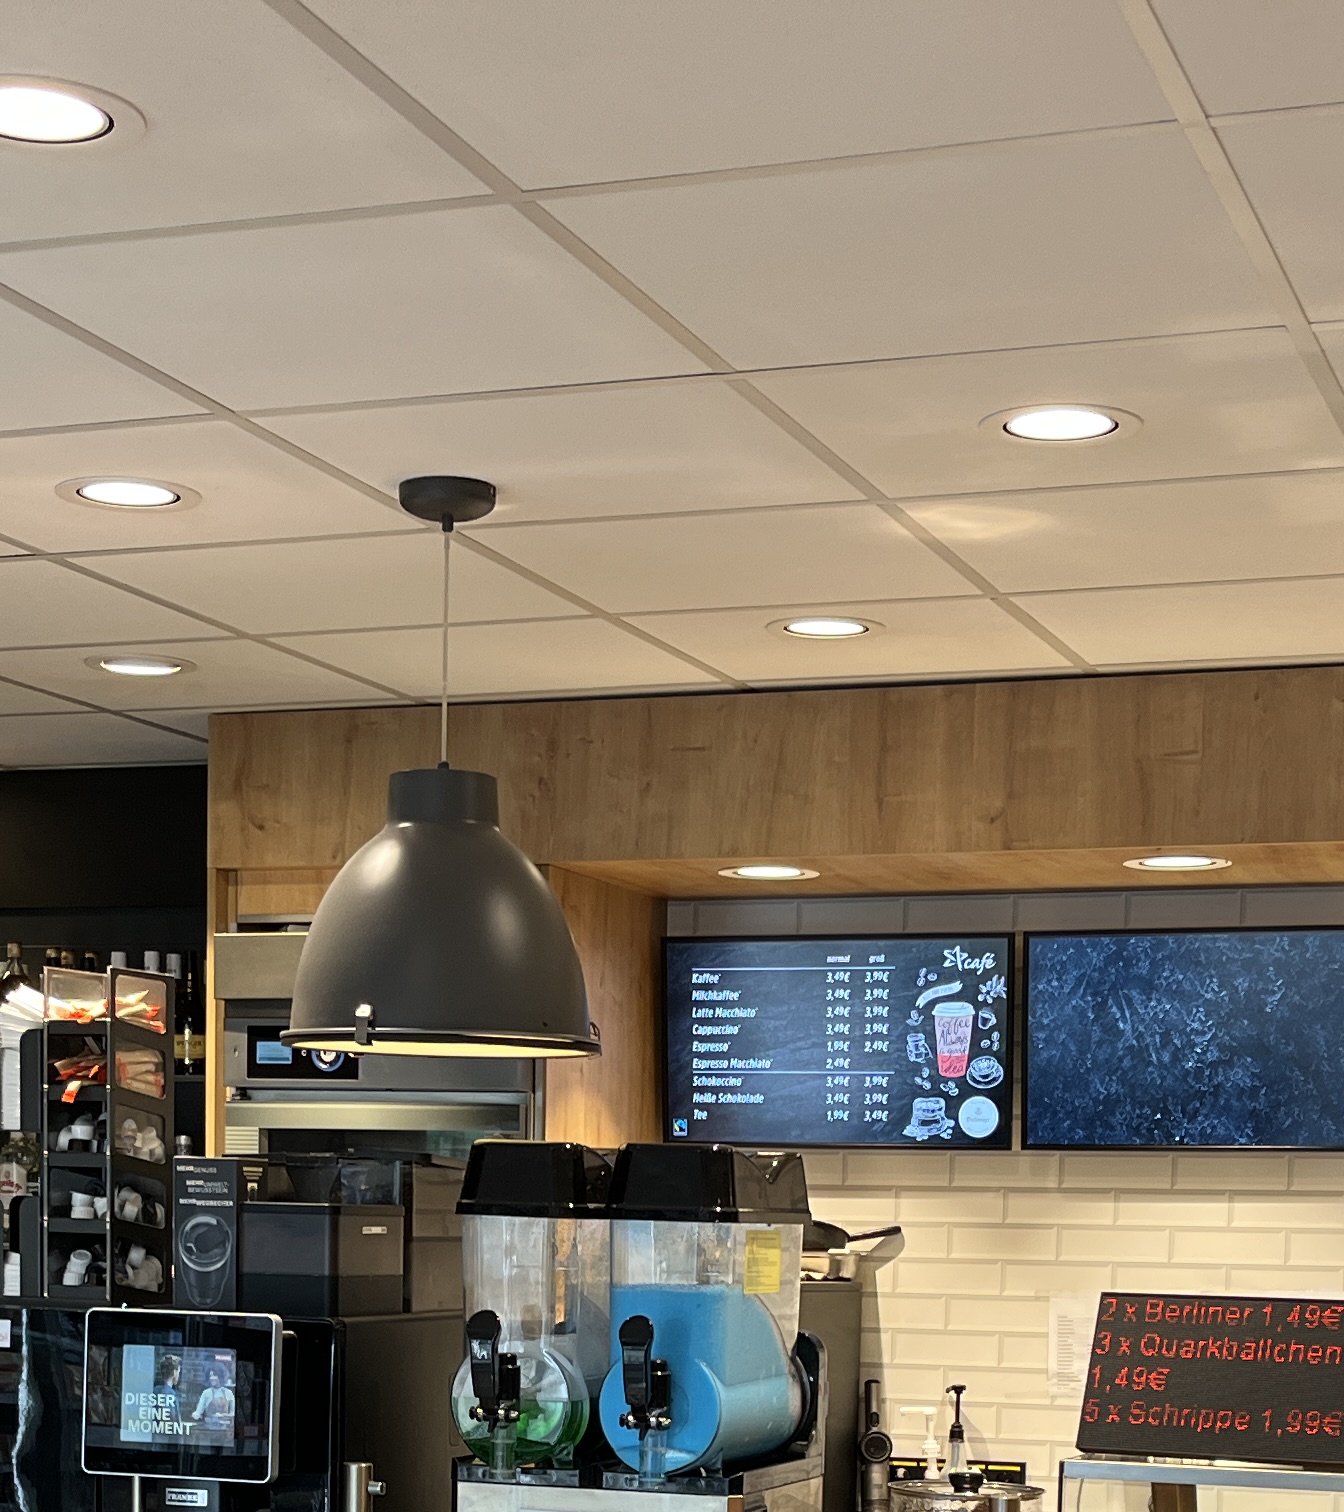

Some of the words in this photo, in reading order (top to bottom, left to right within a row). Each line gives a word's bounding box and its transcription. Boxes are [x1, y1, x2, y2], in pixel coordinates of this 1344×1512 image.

[693, 1110, 707, 1121] Tee
[1101, 1298, 1117, 1323] 2
[1144, 1299, 1254, 1328] Berliner
[1262, 1303, 1344, 1332] 1,49€
[1095, 1331, 1113, 1355] 3
[1091, 1365, 1171, 1394] 1,49€
[124, 1392, 176, 1408] DIESER
[139, 1406, 171, 1421] EINE
[1083, 1398, 1101, 1423] 5
[1128, 1401, 1251, 1434] Schrippe
[128, 1420, 193, 1436] MOMENT
